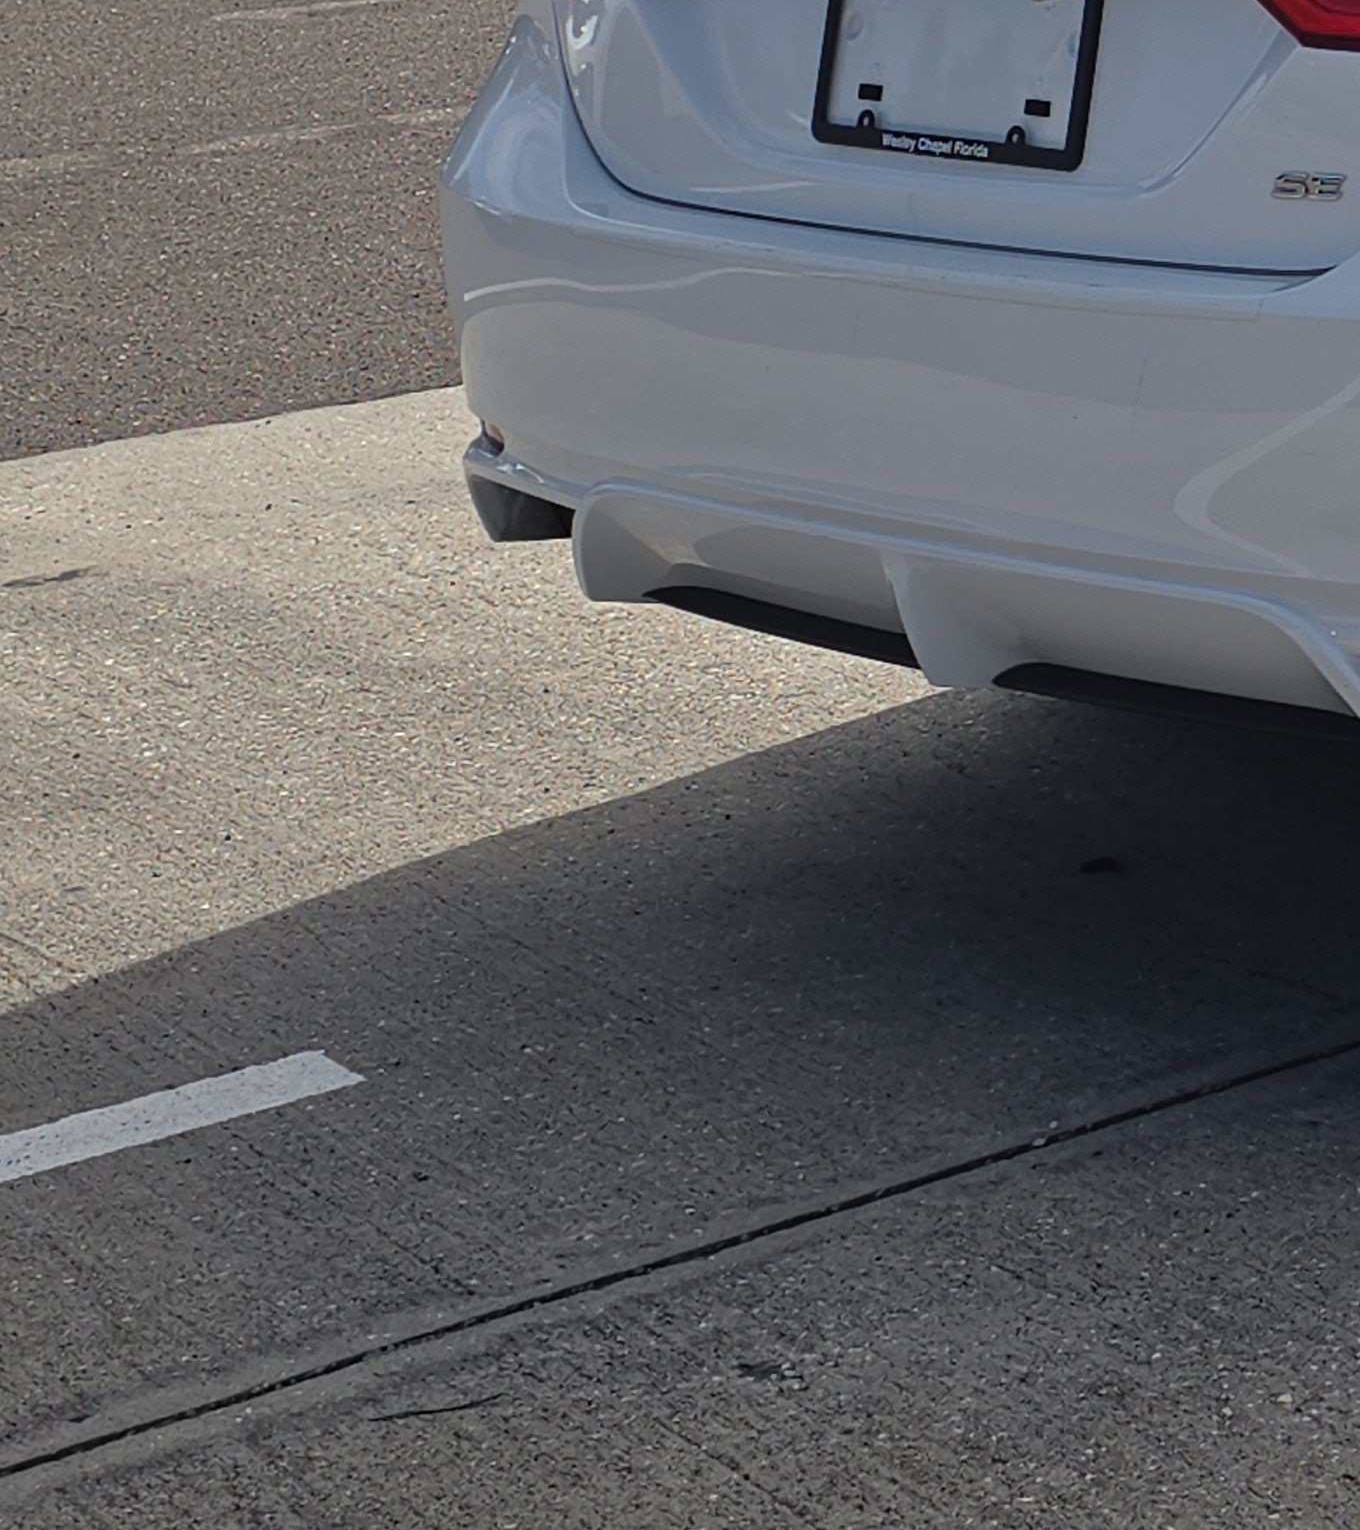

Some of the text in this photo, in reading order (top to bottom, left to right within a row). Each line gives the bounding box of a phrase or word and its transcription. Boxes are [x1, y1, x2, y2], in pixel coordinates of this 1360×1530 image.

[882, 132, 989, 158] Wesley Chapel Florida
[1271, 170, 1348, 202] SE
